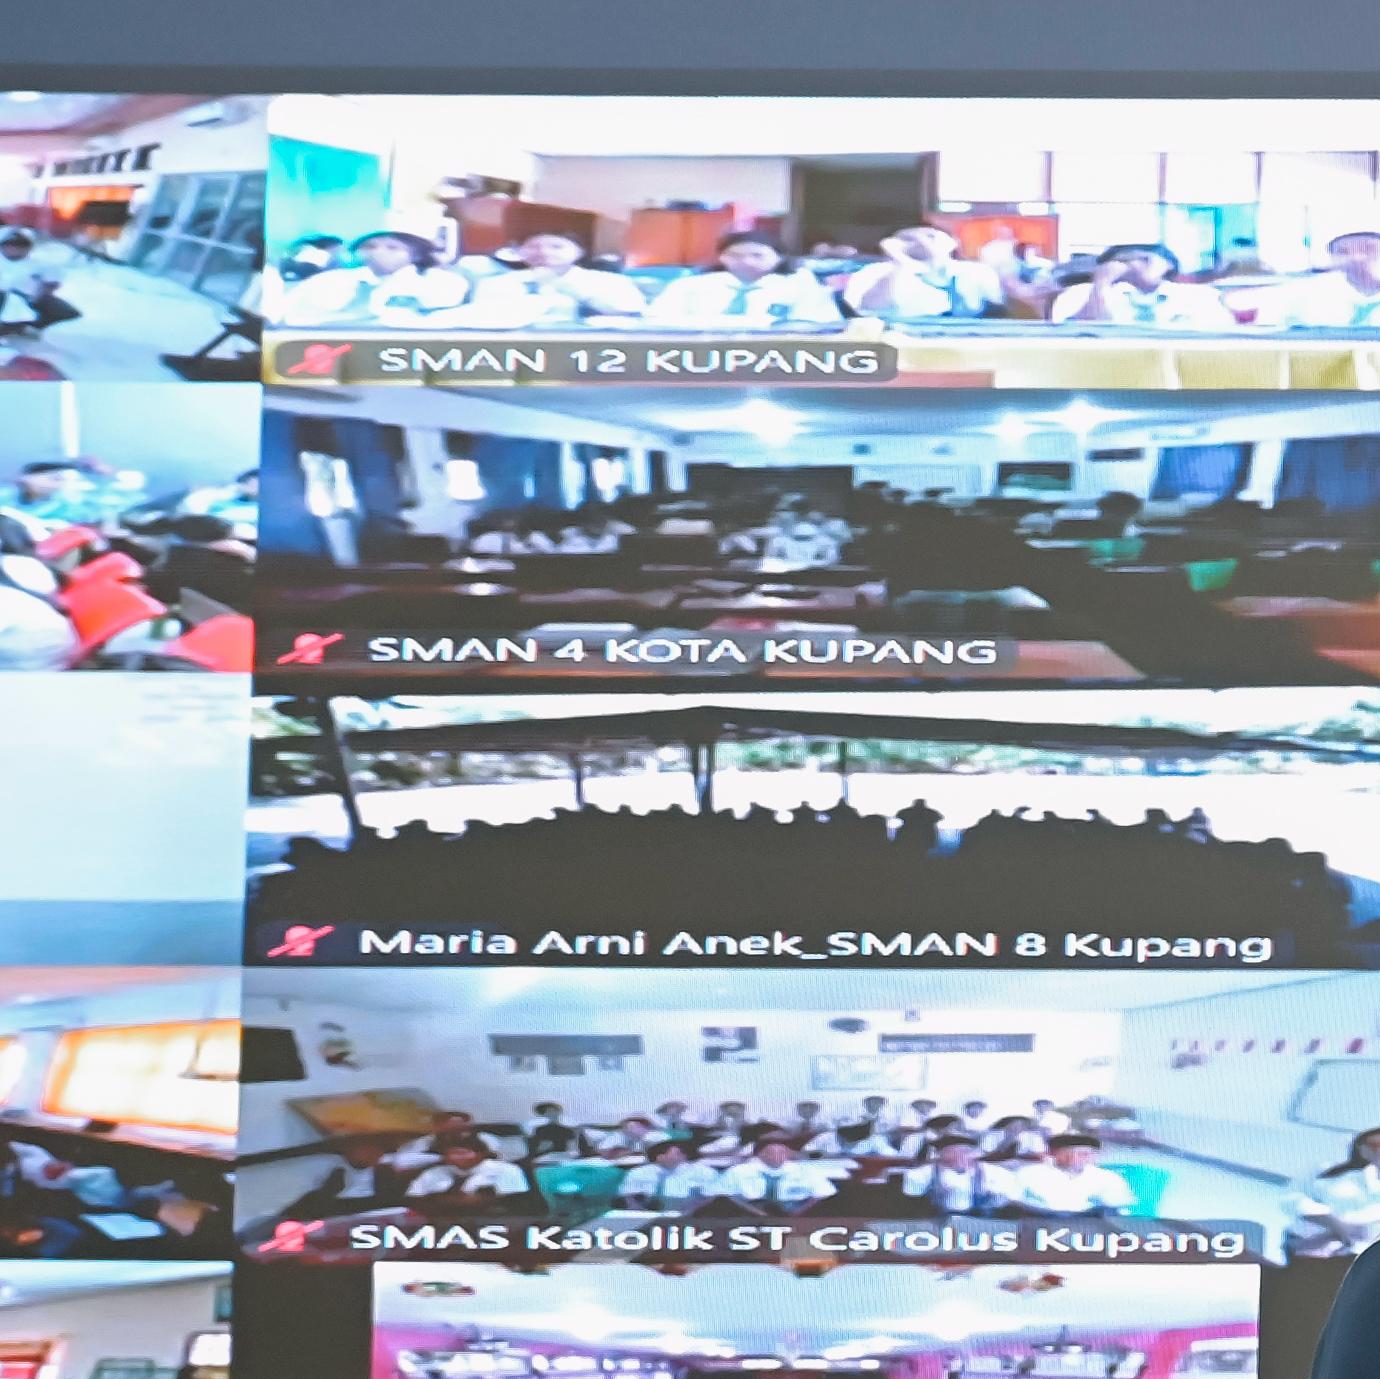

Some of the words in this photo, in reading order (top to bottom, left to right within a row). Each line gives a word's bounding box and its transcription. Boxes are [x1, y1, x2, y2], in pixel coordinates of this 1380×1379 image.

[378, 347, 547, 375] SMAN
[570, 347, 627, 375] 12
[645, 347, 880, 375] KUPANG
[367, 635, 536, 665] SMAN
[554, 637, 587, 665] 4
[605, 637, 747, 665] KOTA
[763, 637, 999, 666] KUPANG
[359, 929, 517, 956] Maria
[532, 929, 645, 956] Arni
[663, 929, 999, 961] Anek_SMAN
[1015, 932, 1047, 958] 8
[1064, 932, 1273, 965] Kupang
[350, 1223, 510, 1251] SMAS
[526, 1224, 713, 1252] Katolik
[728, 1226, 793, 1252] ST
[809, 1226, 1019, 1254] Carolus
[1036, 1226, 1246, 1259] Kupang
